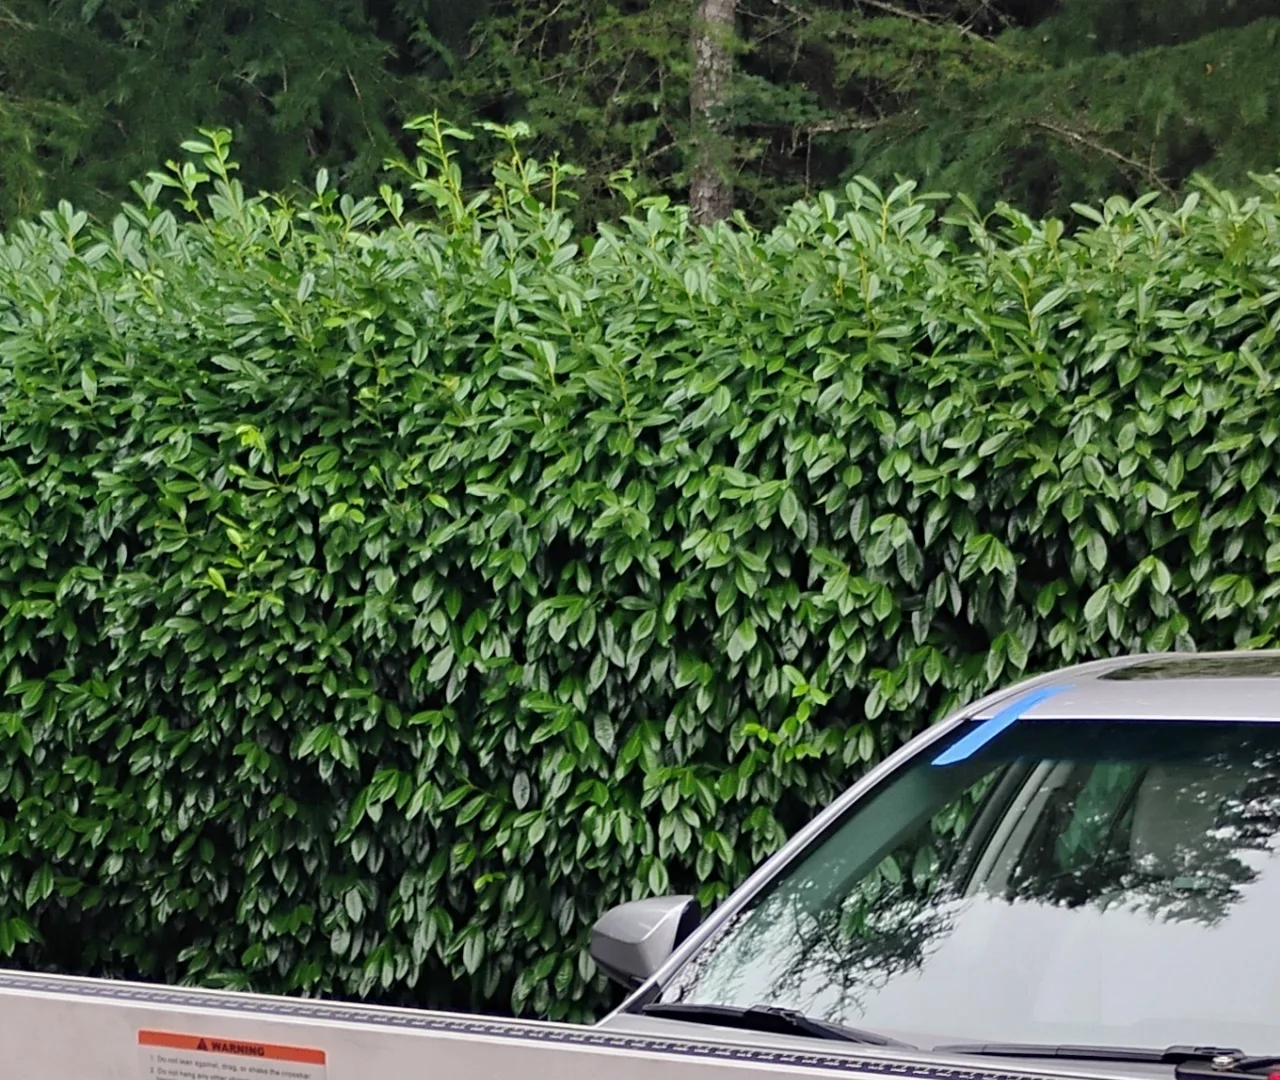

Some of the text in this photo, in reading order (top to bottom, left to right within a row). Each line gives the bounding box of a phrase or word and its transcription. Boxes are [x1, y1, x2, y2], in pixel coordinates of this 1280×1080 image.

[211, 1042, 265, 1057] WARNING
[157, 1055, 166, 1063] Do
[168, 1056, 178, 1064] not
